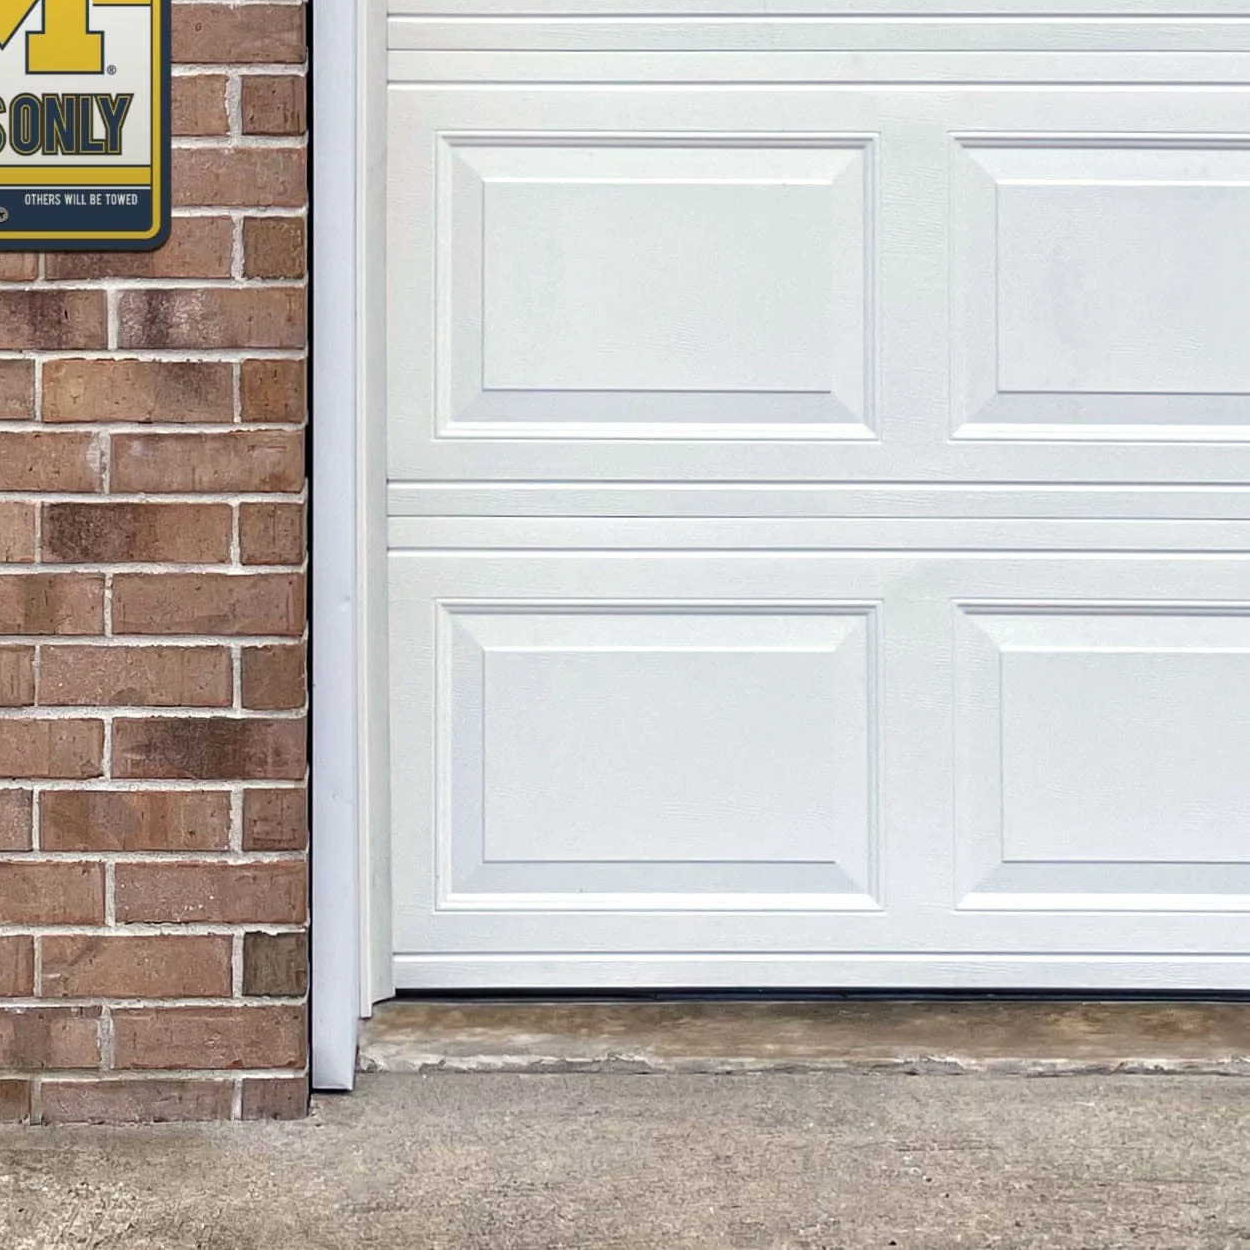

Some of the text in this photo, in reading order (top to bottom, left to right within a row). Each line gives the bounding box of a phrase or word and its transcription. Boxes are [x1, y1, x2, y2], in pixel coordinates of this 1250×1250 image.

[24, 193, 138, 206] OTHERS WILL BE TOWED
